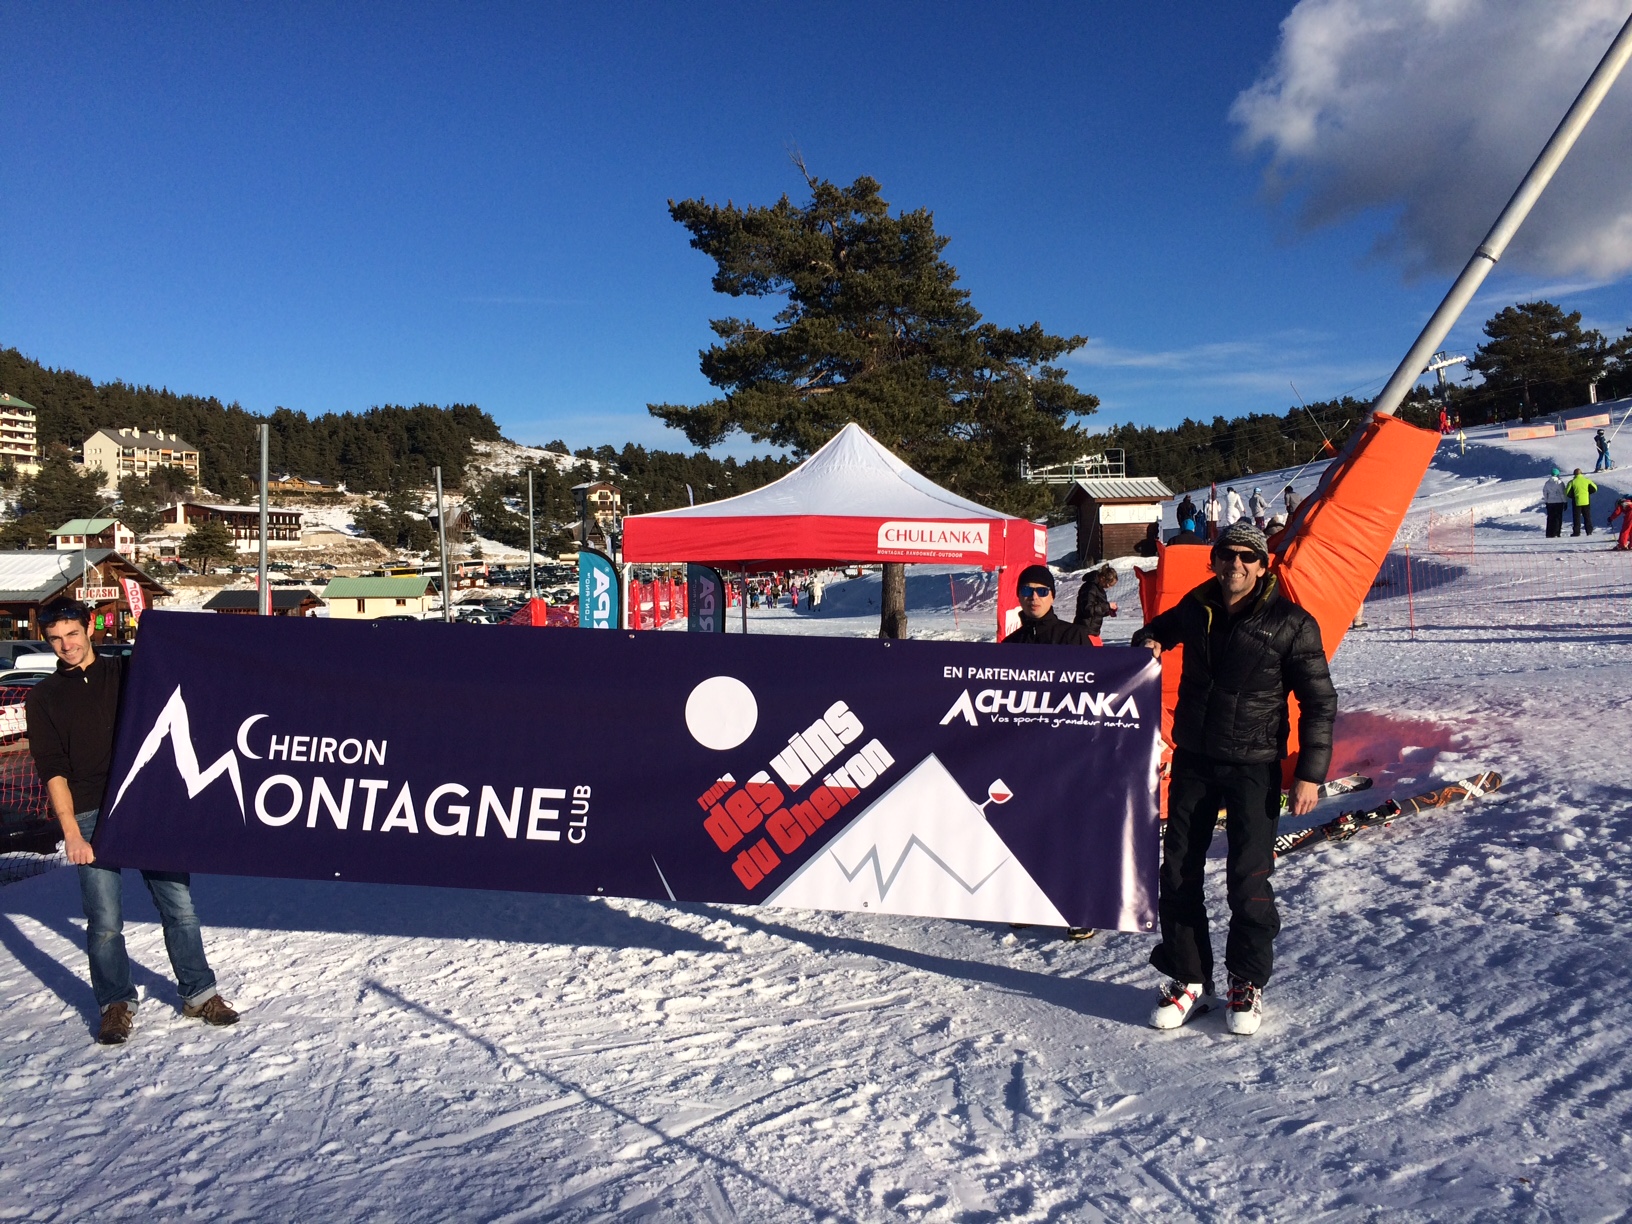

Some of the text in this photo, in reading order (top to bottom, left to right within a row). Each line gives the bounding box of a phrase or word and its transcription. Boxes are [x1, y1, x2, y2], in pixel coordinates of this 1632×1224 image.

[884, 528, 984, 544] CHULLANKA
[943, 666, 1095, 684] EN PARTENARIAT AVEC
[974, 689, 1140, 719] CHULLANKA
[991, 714, 1140, 729] Vos sports grandeur nature
[703, 700, 864, 853] des vins
[568, 784, 592, 844] CLUB
[731, 738, 896, 891] du Cheiron
